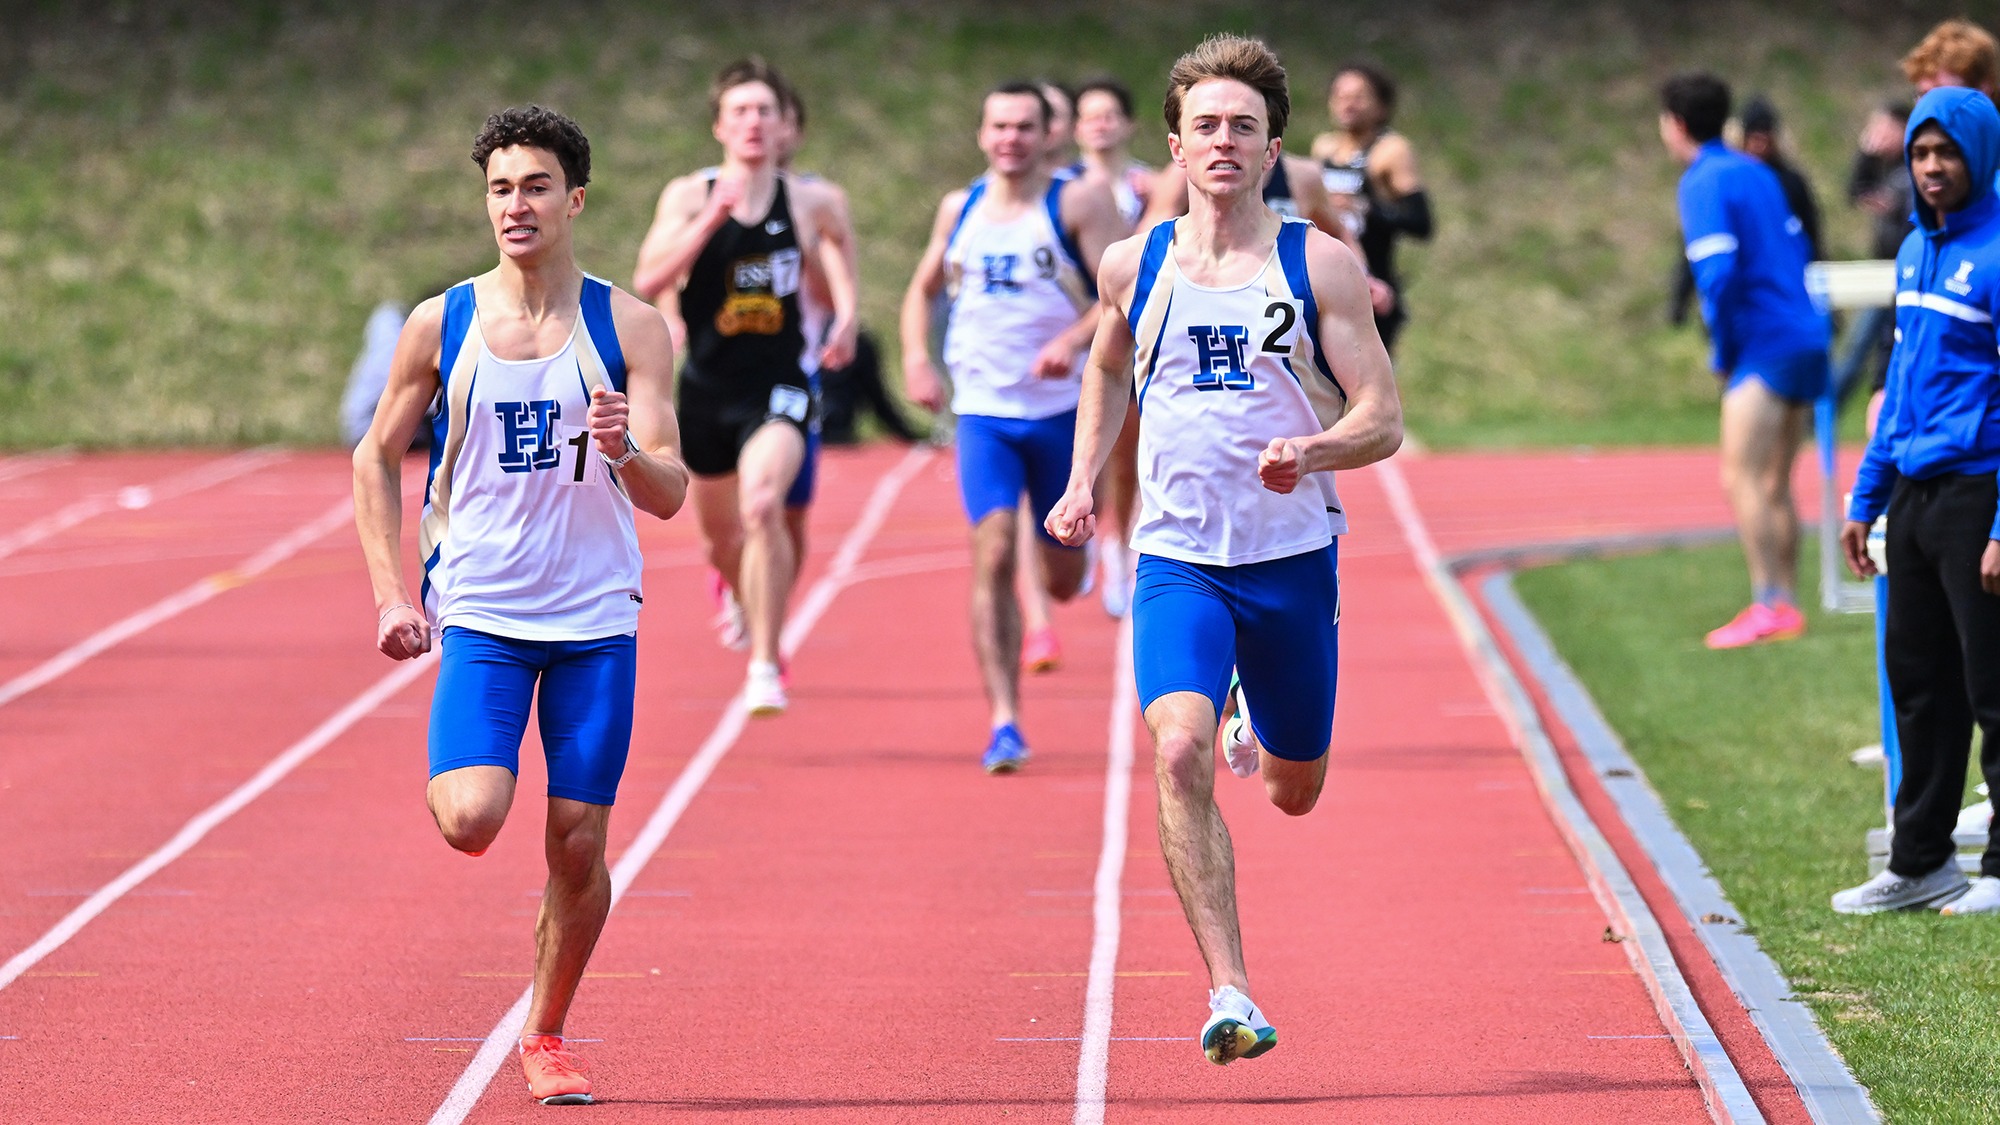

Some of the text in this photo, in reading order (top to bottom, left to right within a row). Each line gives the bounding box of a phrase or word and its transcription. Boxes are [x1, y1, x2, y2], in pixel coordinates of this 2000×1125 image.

[983, 255, 1023, 294] H
[1034, 247, 1056, 280] 9
[1261, 302, 1296, 354] 2
[1187, 325, 1255, 392] H
[494, 400, 561, 473] H
[568, 431, 590, 482] 1
